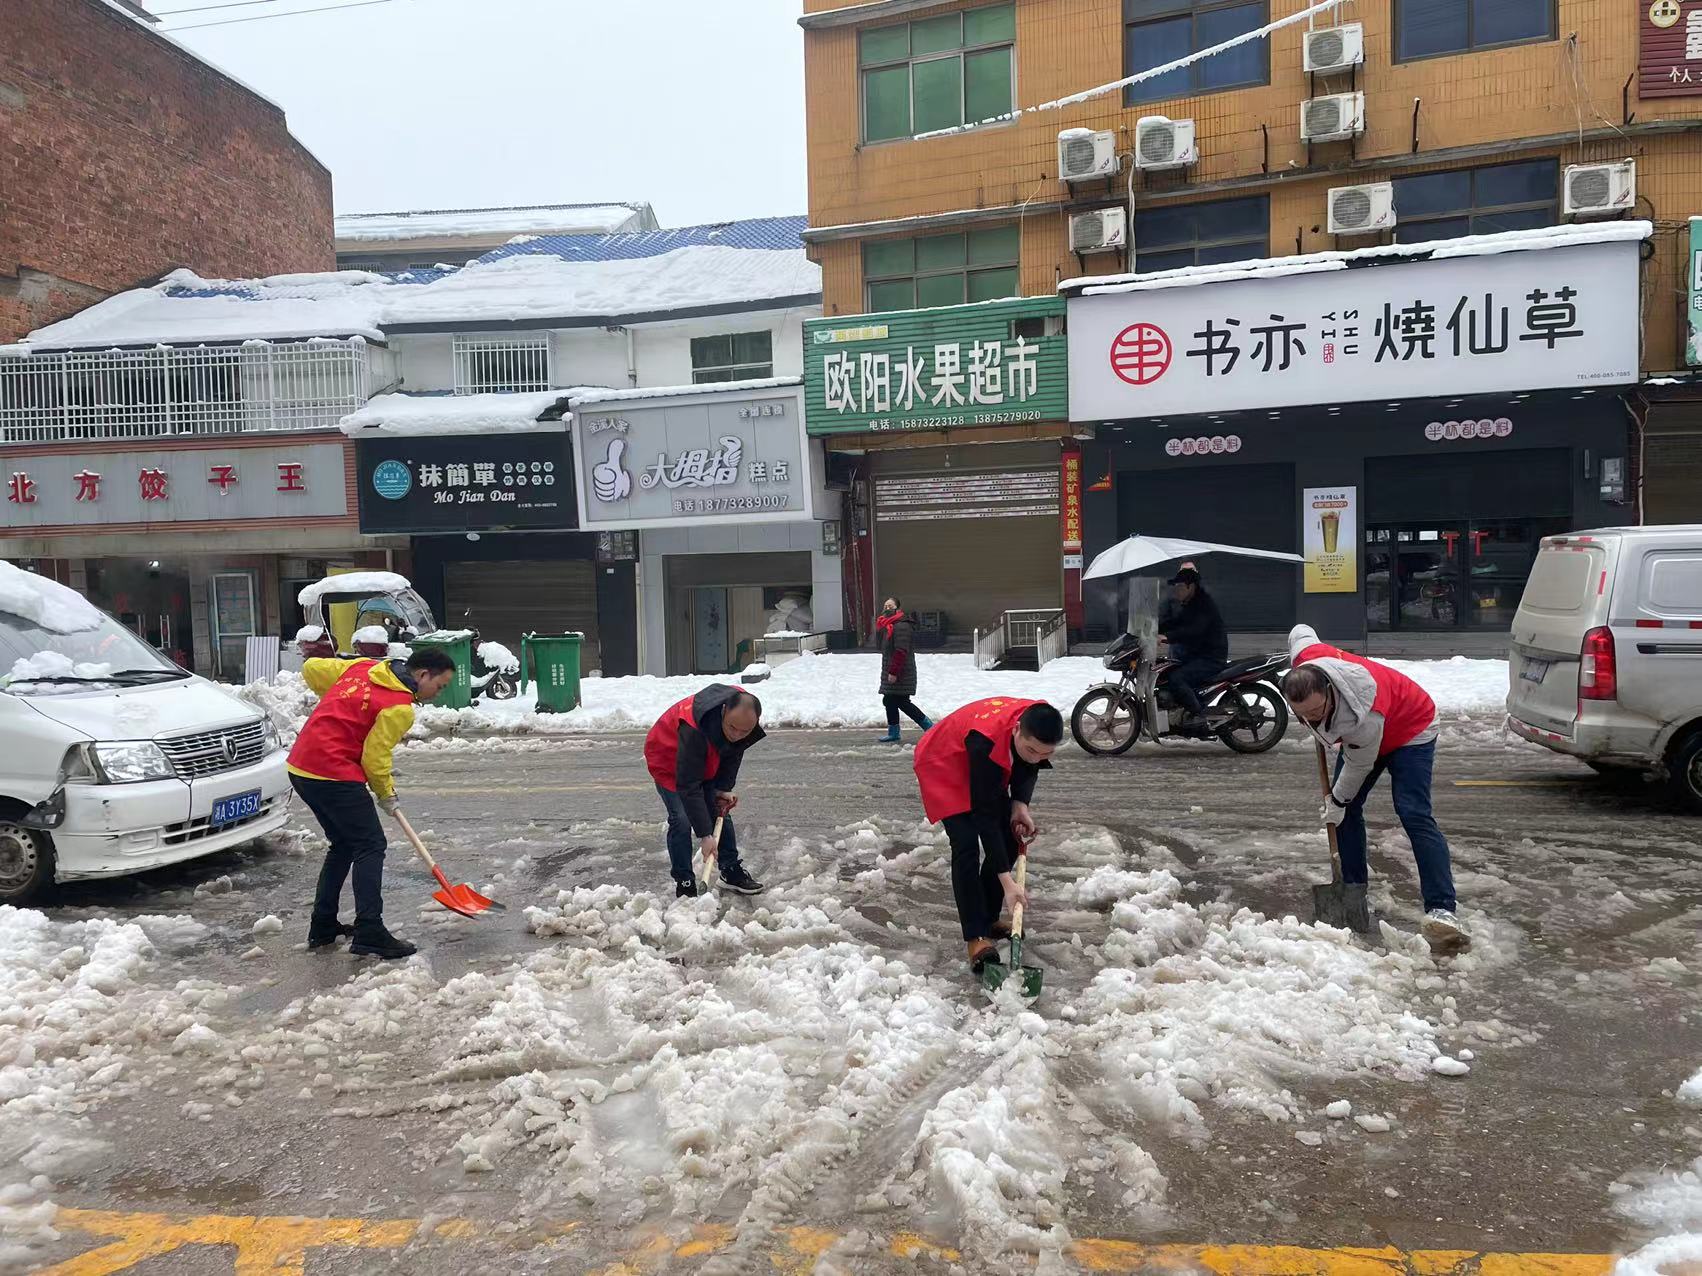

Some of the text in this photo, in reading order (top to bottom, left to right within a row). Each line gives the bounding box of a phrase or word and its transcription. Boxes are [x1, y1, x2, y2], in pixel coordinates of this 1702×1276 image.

[1669, 66, 1702, 83] 个人
[1321, 311, 1336, 340] YI
[1343, 309, 1359, 355] SHU
[1185, 313, 1308, 377] 书亦
[823, 334, 1040, 415] 欧阳水果超市
[900, 416, 964, 430] 15873223128
[974, 411, 1041, 425] 13875279020
[1427, 419, 1511, 439] 半杯都是料
[1166, 436, 1240, 455] 半杯都是料
[748, 461, 789, 483] 糕点
[8, 463, 308, 504] 北方饺子王
[433, 490, 516, 505] Mo Jian Dan
[673, 495, 789, 512] 电话 18773289007
[1065, 458, 1080, 542] 桶装矿泉水配送
